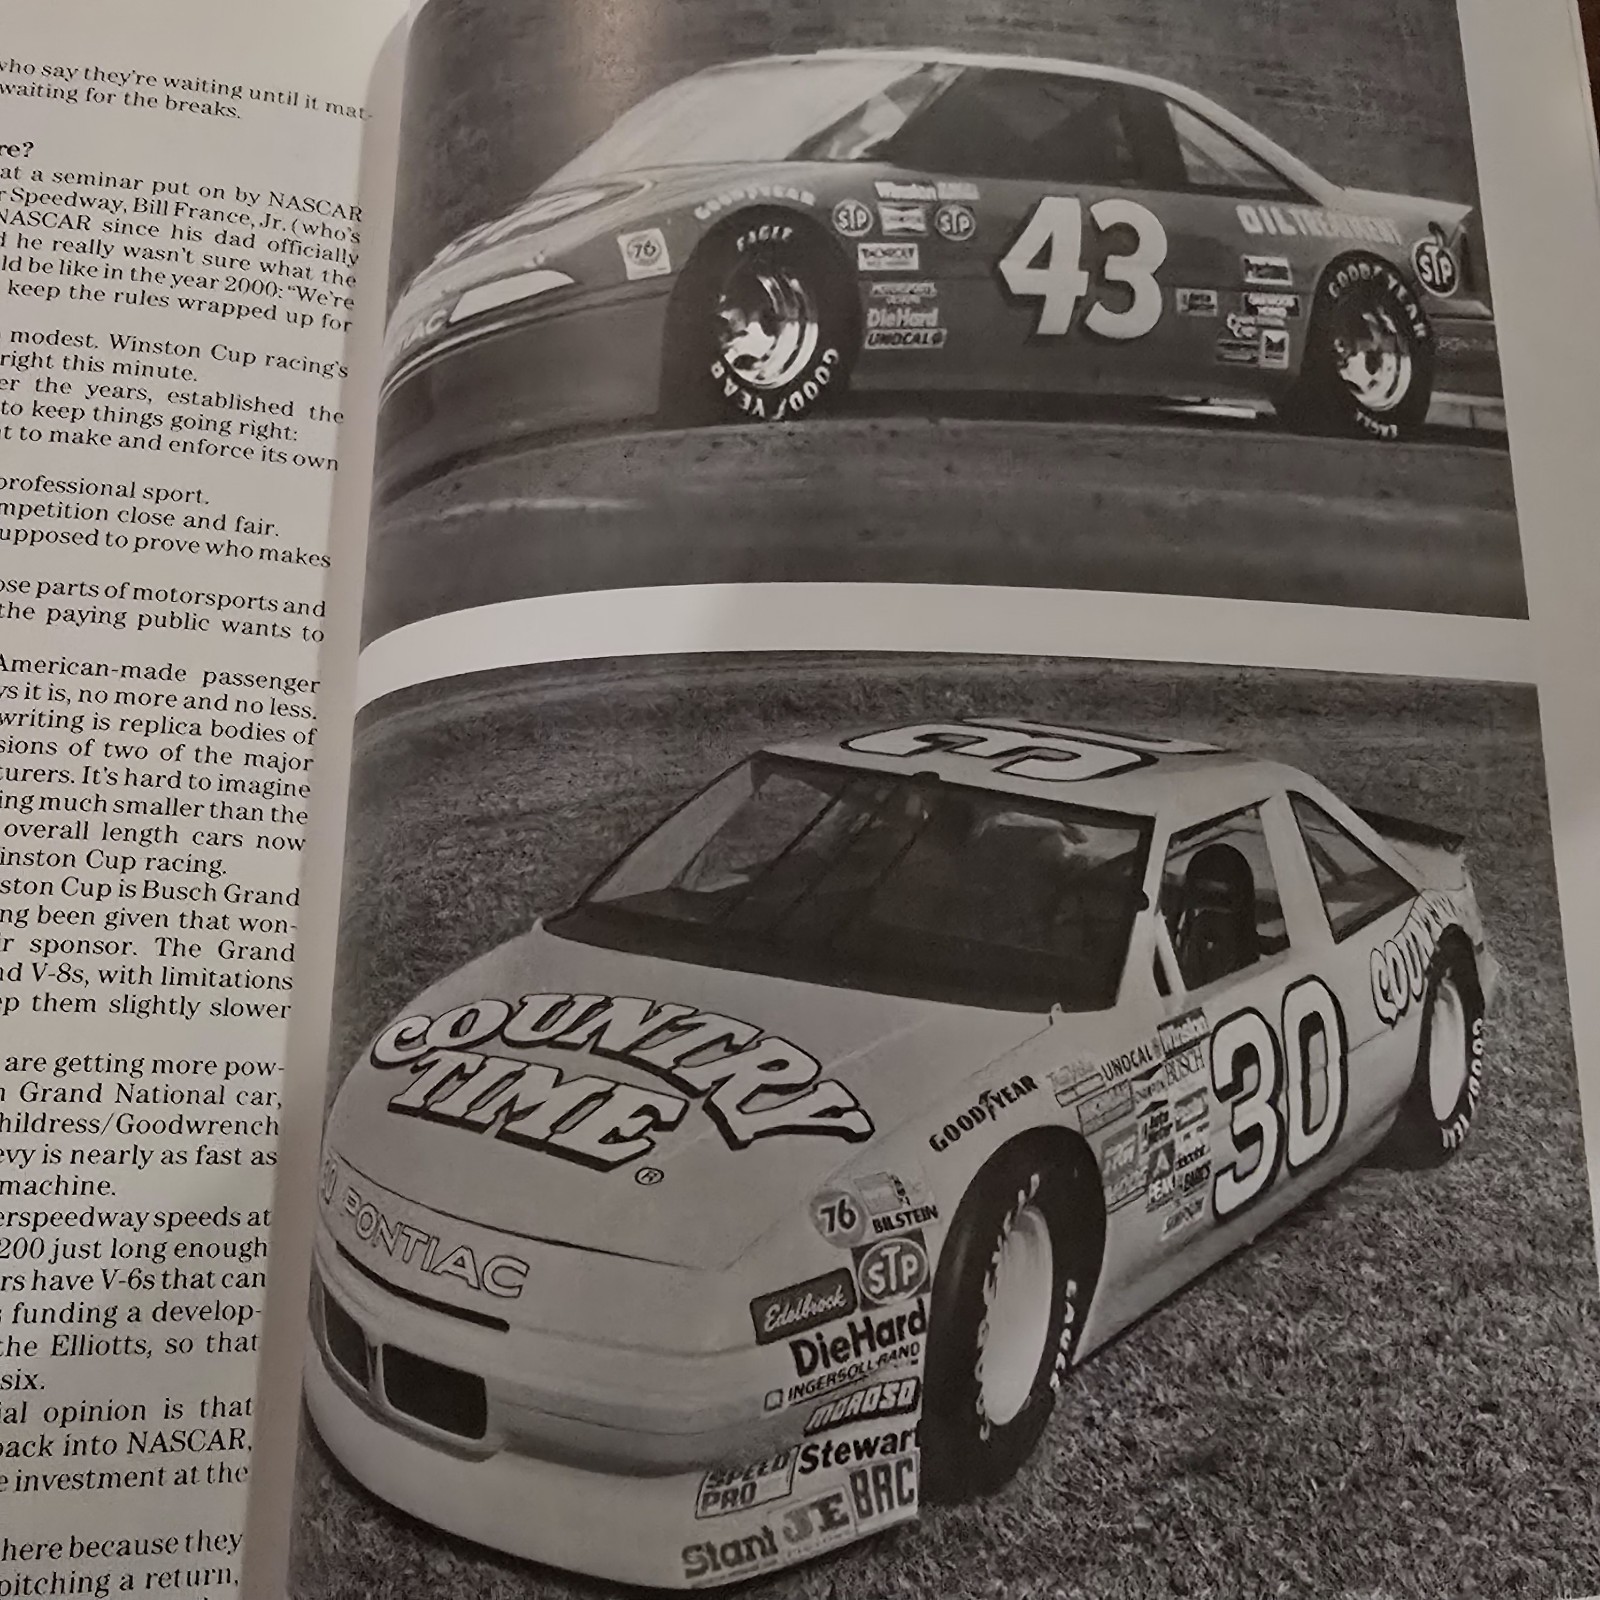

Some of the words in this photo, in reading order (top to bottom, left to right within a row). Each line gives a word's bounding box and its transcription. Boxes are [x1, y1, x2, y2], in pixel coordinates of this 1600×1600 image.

[41, 65, 79, 82] say
[84, 66, 157, 87] they're
[163, 77, 242, 100] waiting
[250, 89, 298, 106] until
[305, 94, 316, 110] it
[326, 103, 372, 119] mat-
[86, 87, 116, 104] for
[124, 91, 157, 108] the
[166, 95, 240, 118] breaks.
[0, 166, 21, 180] at
[31, 170, 43, 182] a
[52, 172, 144, 190] seminar
[152, 181, 189, 195] put
[199, 187, 224, 199] on
[236, 186, 260, 207] by
[268, 191, 362, 222] NASCAR
[12, 187, 127, 214] Speedway,
[133, 197, 168, 216] Bill
[174, 202, 256, 229] France,
[259, 213, 287, 231] Jr.
[292, 218, 361, 244] (who's
[838, 204, 867, 229] STP
[939, 205, 970, 233] STP
[17, 233, 42, 250] he
[53, 239, 115, 259] really
[124, 246, 194, 264] wasn't
[202, 255, 250, 271] sure
[260, 260, 313, 280] what
[322, 269, 356, 288] the
[632, 240, 656, 259] 76
[1418, 244, 1454, 286] STP
[998, 196, 1168, 339] 43
[29, 257, 53, 274] be
[59, 259, 98, 278] like
[103, 263, 123, 280] in
[131, 266, 166, 284] the
[170, 274, 219, 289] year
[225, 276, 283, 298] 2000:
[288, 285, 354, 311] "We're
[0, 351, 54, 372] right
[63, 355, 104, 372] this
[112, 360, 197, 381] minute.
[11, 330, 98, 349] modest.
[110, 334, 200, 358] Winston
[211, 344, 256, 367] Cup
[266, 355, 348, 379] racing's
[1, 400, 23, 416] to
[32, 400, 85, 423] keep
[93, 405, 163, 429] things
[170, 414, 232, 437] going
[239, 419, 297, 441] right:
[143, 488, 209, 504] sport.
[117, 506, 175, 526] close
[183, 514, 226, 531] and
[235, 515, 278, 536] fair.
[36, 581, 99, 598] parts
[104, 581, 130, 600] of
[133, 585, 279, 612] motorsports
[283, 601, 326, 617] and
[46, 606, 127, 629] paying
[137, 611, 209, 631] public
[222, 620, 291, 639] wants
[303, 626, 324, 642] to
[201, 671, 320, 695] passenger
[92, 712, 111, 731] is
[119, 715, 202, 737] replica
[211, 719, 285, 742] bodies
[293, 728, 318, 745] of
[68, 738, 95, 756] of
[104, 742, 148, 759] two
[160, 744, 186, 762] of
[195, 745, 232, 765] the
[244, 752, 314, 774] major
[38, 793, 107, 813] much
[113, 797, 205, 817] smaller
[210, 801, 263, 821] than
[272, 804, 308, 825] the
[86, 849, 136, 874] Cup
[145, 854, 226, 879] racing.
[0, 878, 53, 895] ston
[61, 876, 111, 901] Cup
[118, 879, 136, 898] is
[142, 880, 216, 902] Busch
[224, 883, 299, 906] Grand
[30, 939, 137, 958] sponsor.
[155, 937, 201, 958] The
[218, 939, 295, 962] Grand
[32, 962, 89, 988] V-8s,
[98, 965, 152, 985] with
[161, 966, 293, 990] limitations
[5, 1057, 47, 1072] are
[53, 1053, 145, 1079] getting
[151, 1059, 217, 1075] more
[223, 1061, 284, 1080] pow-
[369, 992, 876, 1151] COUNTRY
[1101, 1044, 1153, 1082] UNOCAL
[20, 1081, 102, 1103] Grand
[114, 1083, 224, 1105] National
[236, 1090, 281, 1109] car,
[387, 1049, 691, 1173] TIME
[1209, 973, 1350, 1227] 30
[928, 1074, 1039, 1153] GOODYEAR
[153, 1206, 241, 1232] speeds
[247, 1209, 270, 1226] at
[821, 1198, 857, 1234] 76
[872, 1204, 939, 1234] BILSTEIN
[48, 1238, 101, 1265] just
[110, 1238, 168, 1264] long
[174, 1237, 267, 1263] enough
[31, 1269, 94, 1291] have
[100, 1268, 155, 1291] V-6s
[161, 1267, 216, 1289] that
[221, 1273, 265, 1288] can
[868, 1246, 919, 1296] STP
[763, 1285, 848, 1333] Edelbrock
[50, 1334, 152, 1359] Elliotts,
[165, 1338, 193, 1354] so
[207, 1331, 257, 1353] that
[789, 1298, 928, 1378] DieHard
[0, 1368, 44, 1390] six.
[44, 1399, 145, 1428] opinion
[164, 1398, 183, 1419] is
[201, 1396, 251, 1419] that
[63, 1433, 117, 1456] into
[127, 1428, 251, 1454] NASCAR,
[701, 1481, 757, 1512] PRO
[849, 1457, 915, 1519] BRC
[1, 1538, 63, 1561] here
[69, 1535, 178, 1558] because
[186, 1529, 242, 1555] they
[119, 1574, 134, 1591] a
[146, 1568, 238, 1589] return,
